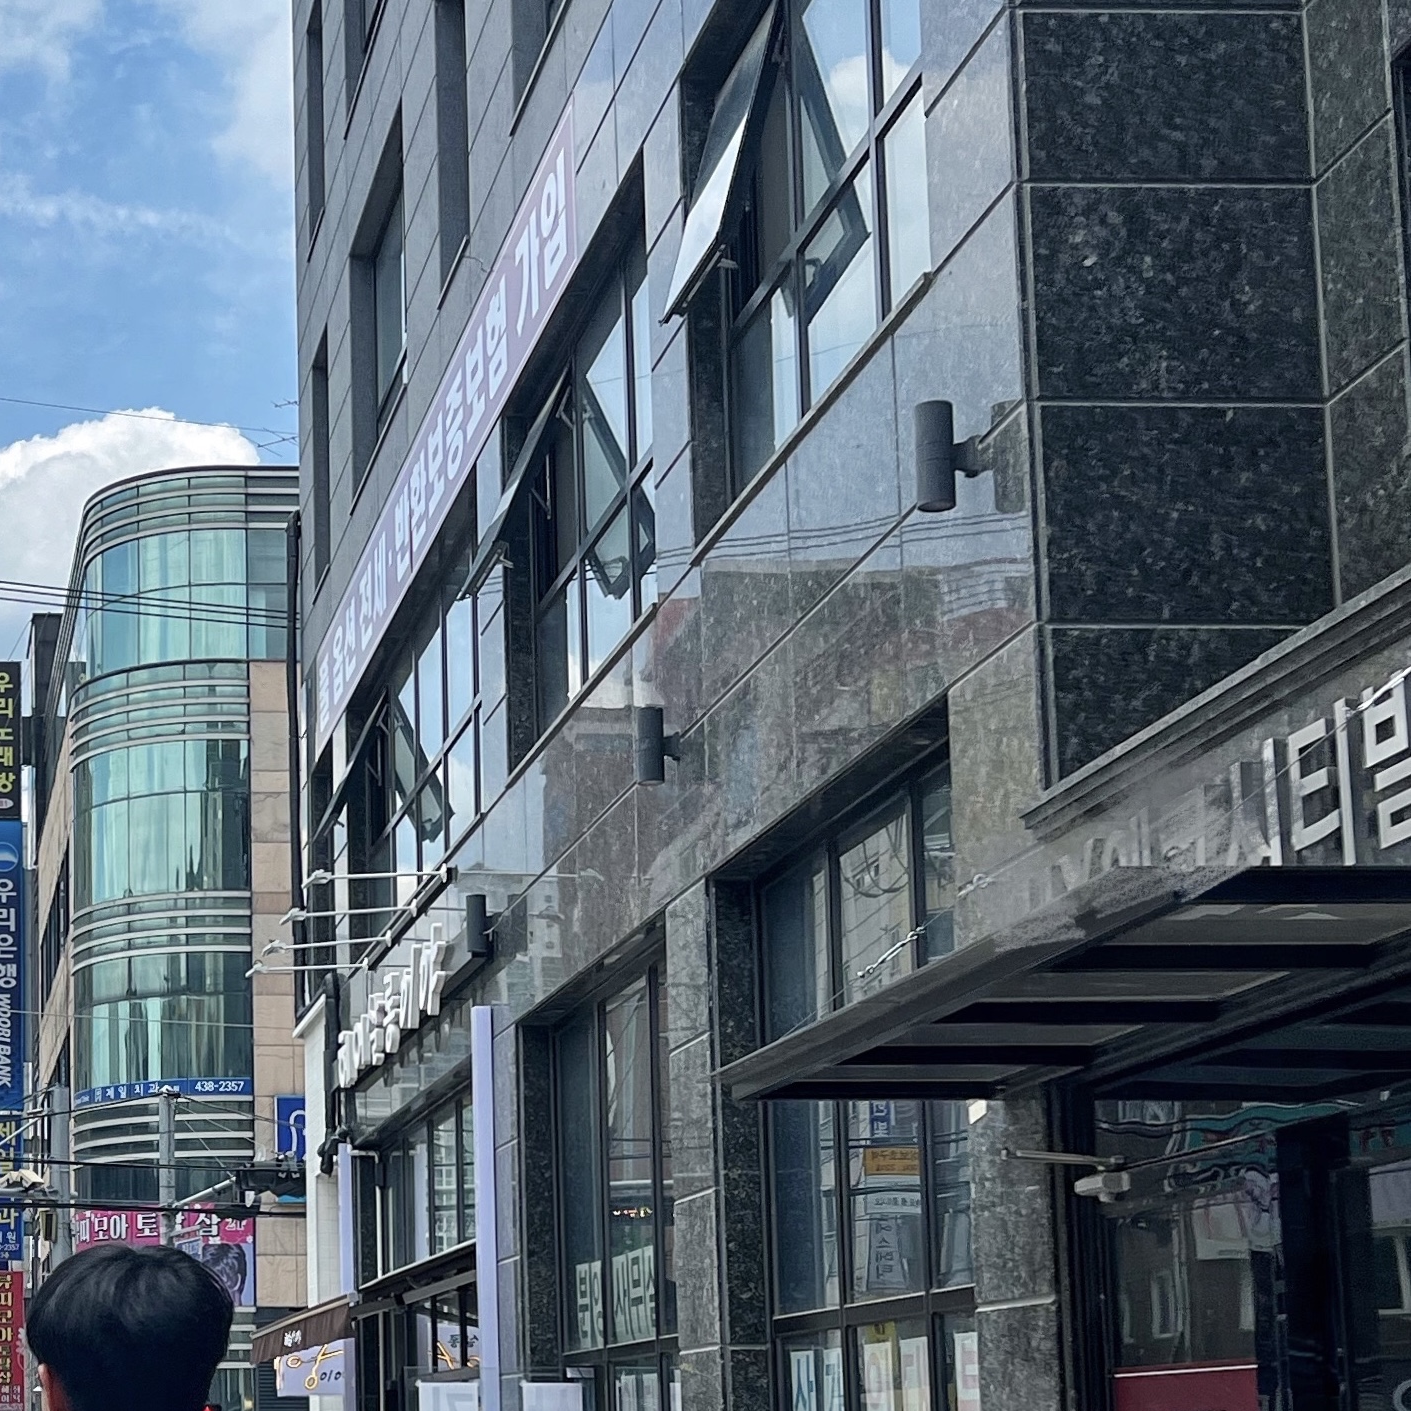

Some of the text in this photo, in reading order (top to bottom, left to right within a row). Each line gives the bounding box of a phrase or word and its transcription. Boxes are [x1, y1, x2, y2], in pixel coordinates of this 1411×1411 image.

[332, 604, 357, 707] 옵션
[514, 146, 568, 338] 가입
[194, 1079, 245, 1092] 438-2357
